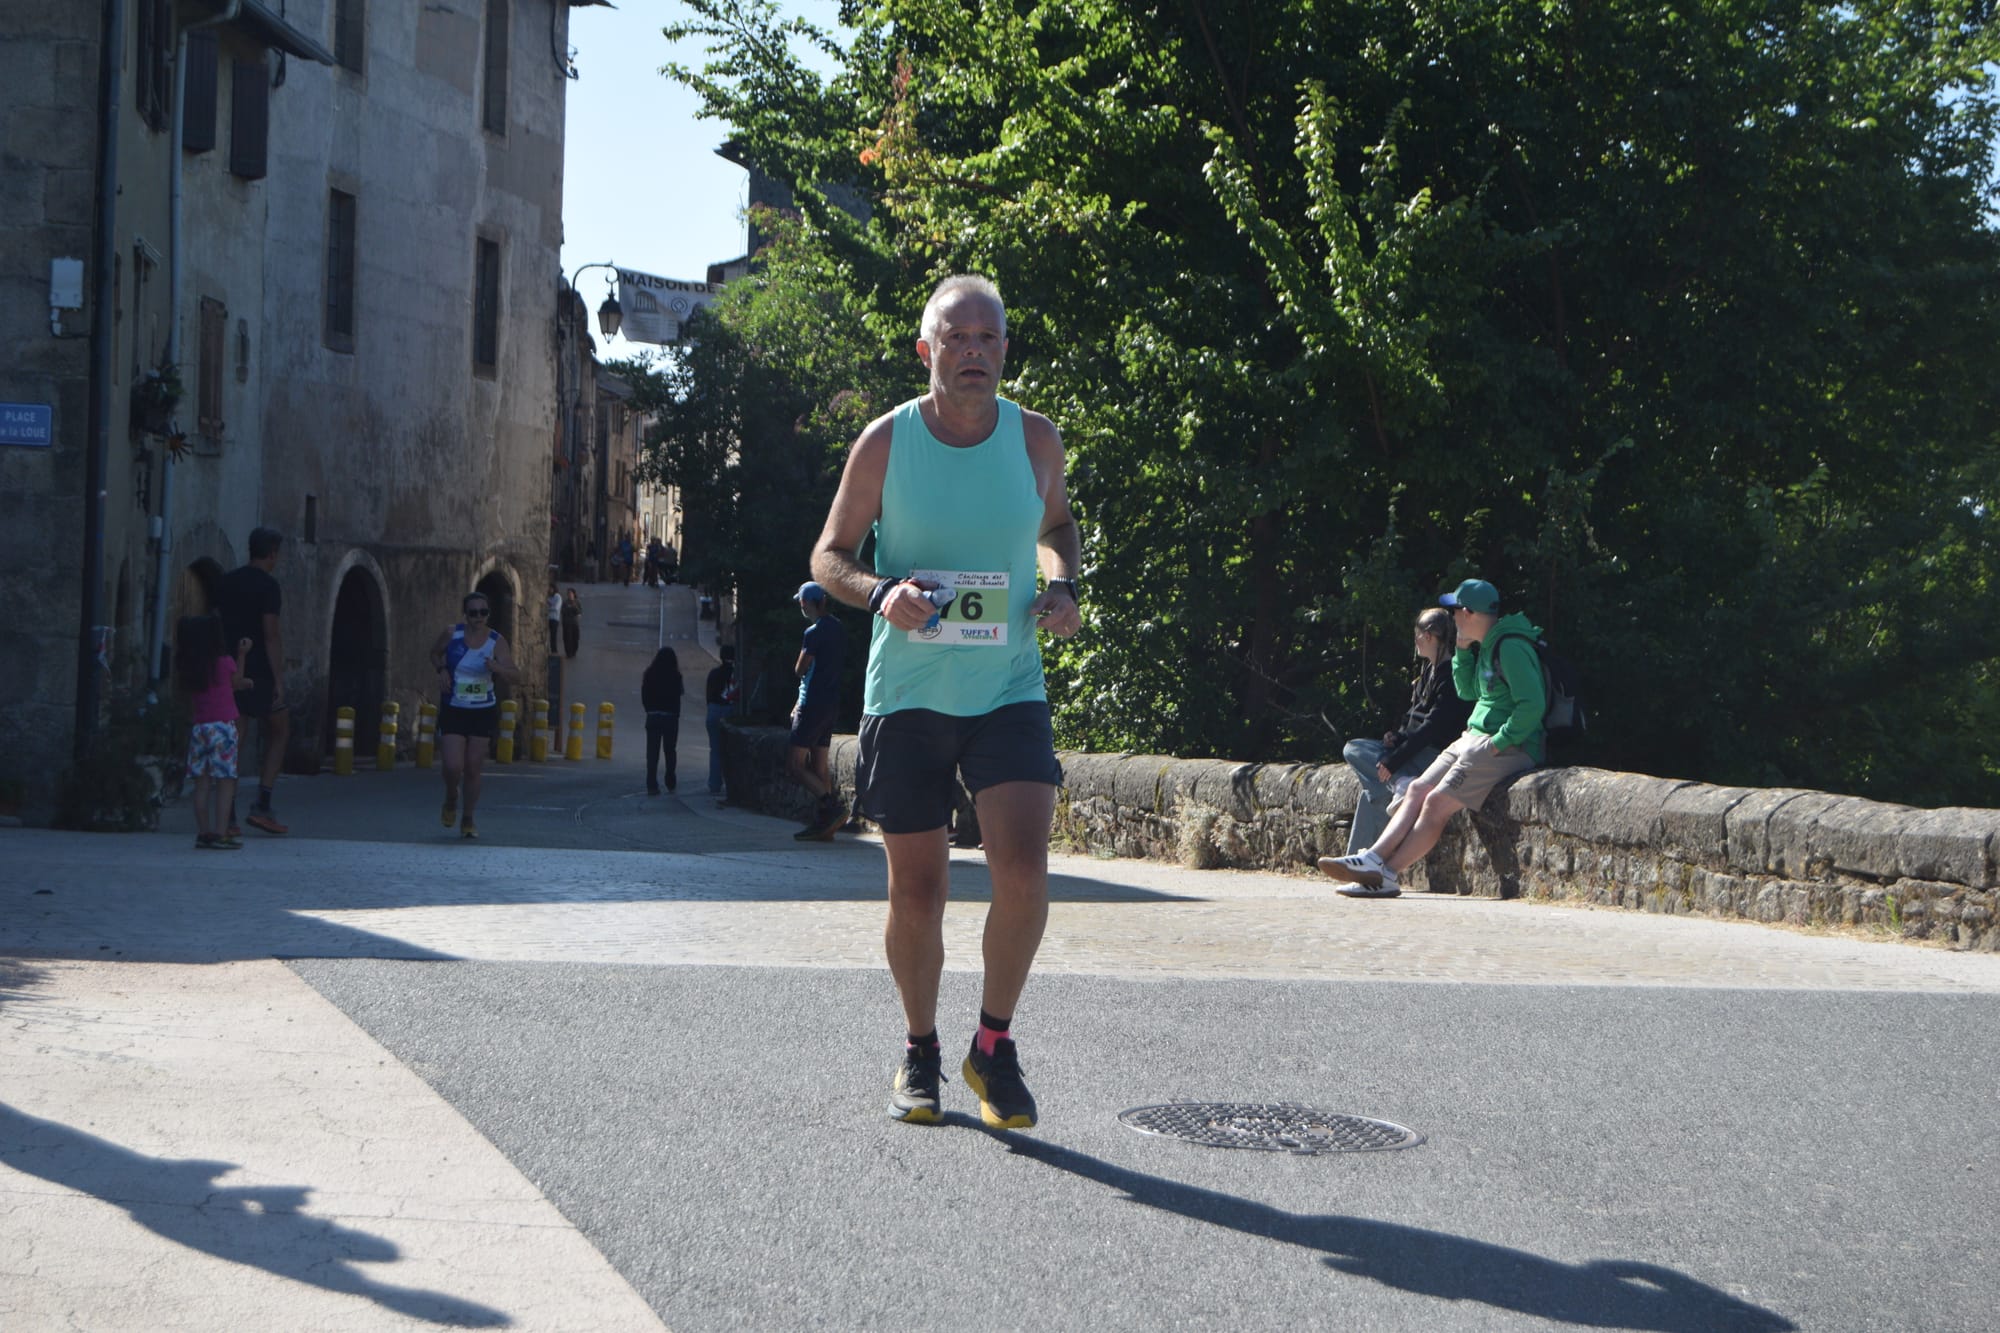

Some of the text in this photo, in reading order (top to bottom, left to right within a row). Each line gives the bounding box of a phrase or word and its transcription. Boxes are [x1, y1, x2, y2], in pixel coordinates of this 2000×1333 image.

[622, 273, 689, 291] MAISON
[5, 411, 37, 422] PLACE
[465, 684, 481, 694] 45
